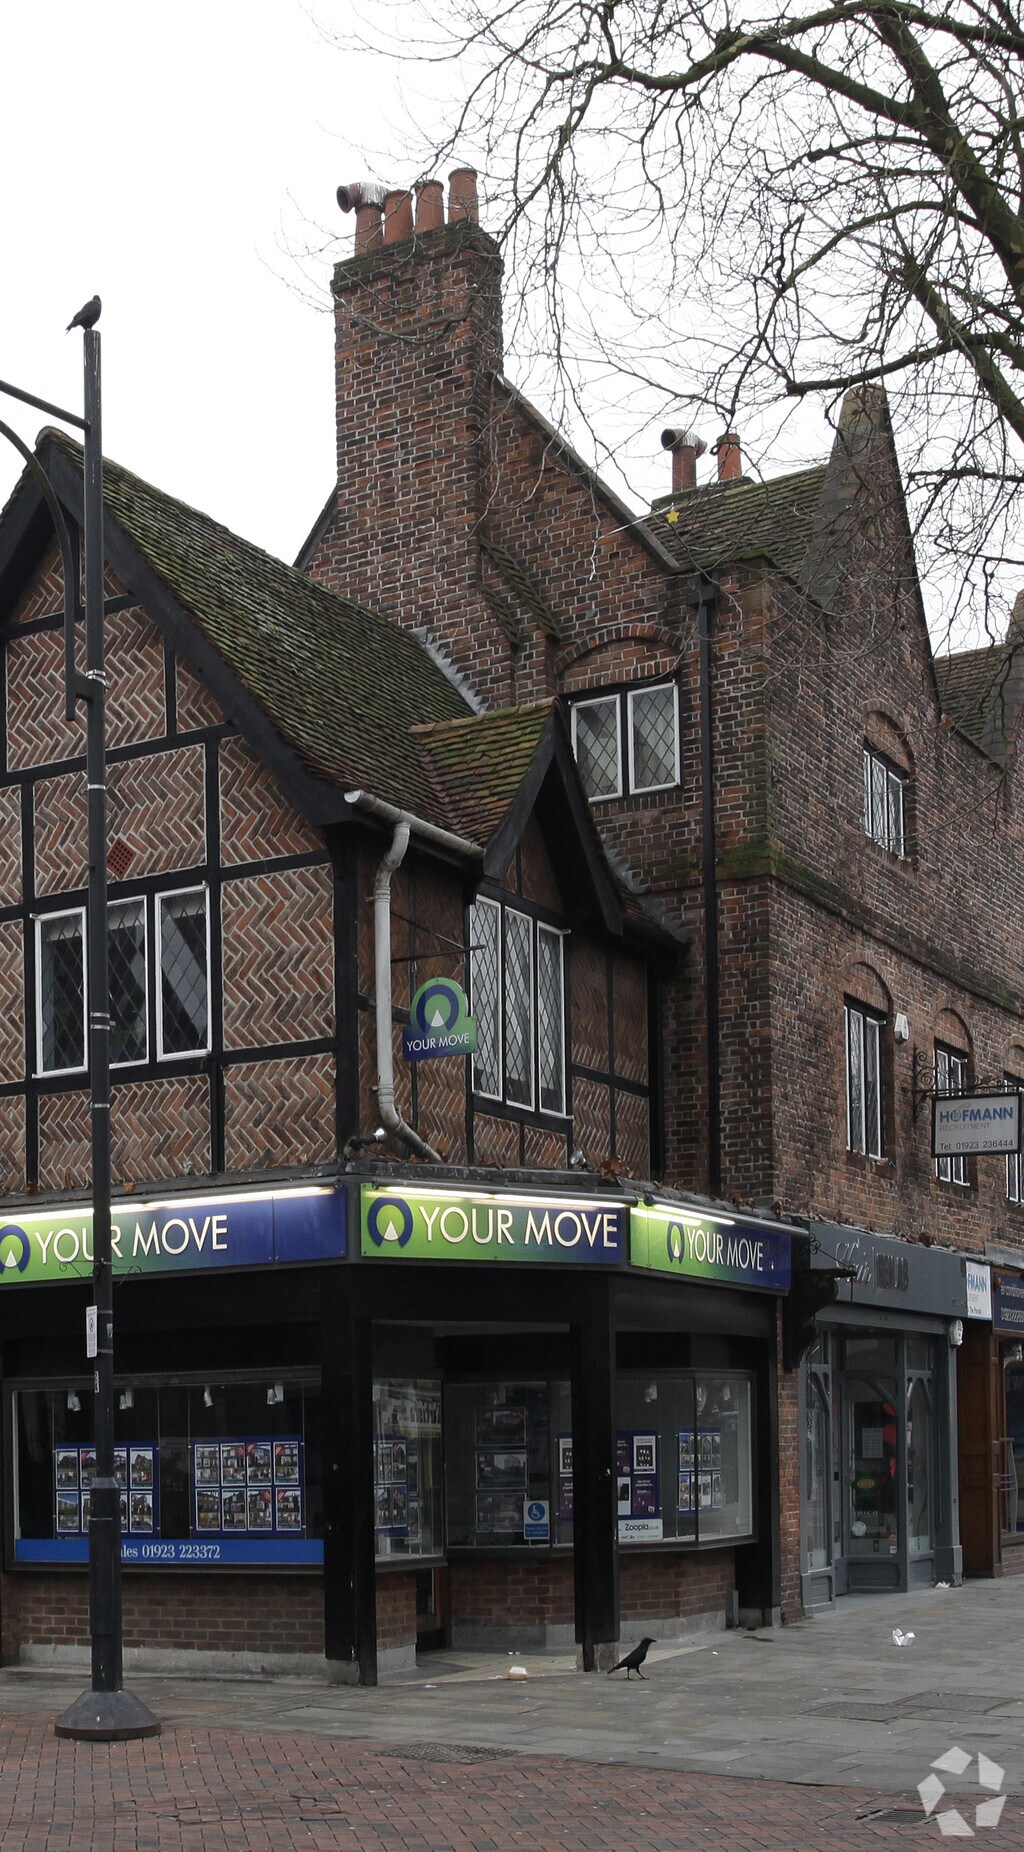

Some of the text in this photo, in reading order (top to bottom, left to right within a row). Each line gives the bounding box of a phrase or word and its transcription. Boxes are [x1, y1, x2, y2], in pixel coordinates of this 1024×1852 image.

[407, 1033, 470, 1052] YOUR MOVE
[939, 1106, 1014, 1123] HOFMANN
[939, 1122, 991, 1132] RECRUITMENT
[956, 1141, 979, 1150] 01923
[982, 1139, 1014, 1149] 236444
[132, 1215, 228, 1258] MOVE
[418, 1206, 618, 1249] YOUR MOVE
[684, 1231, 764, 1272] YOUR MOVE
[121, 1544, 221, 1559] les 01923 223372
